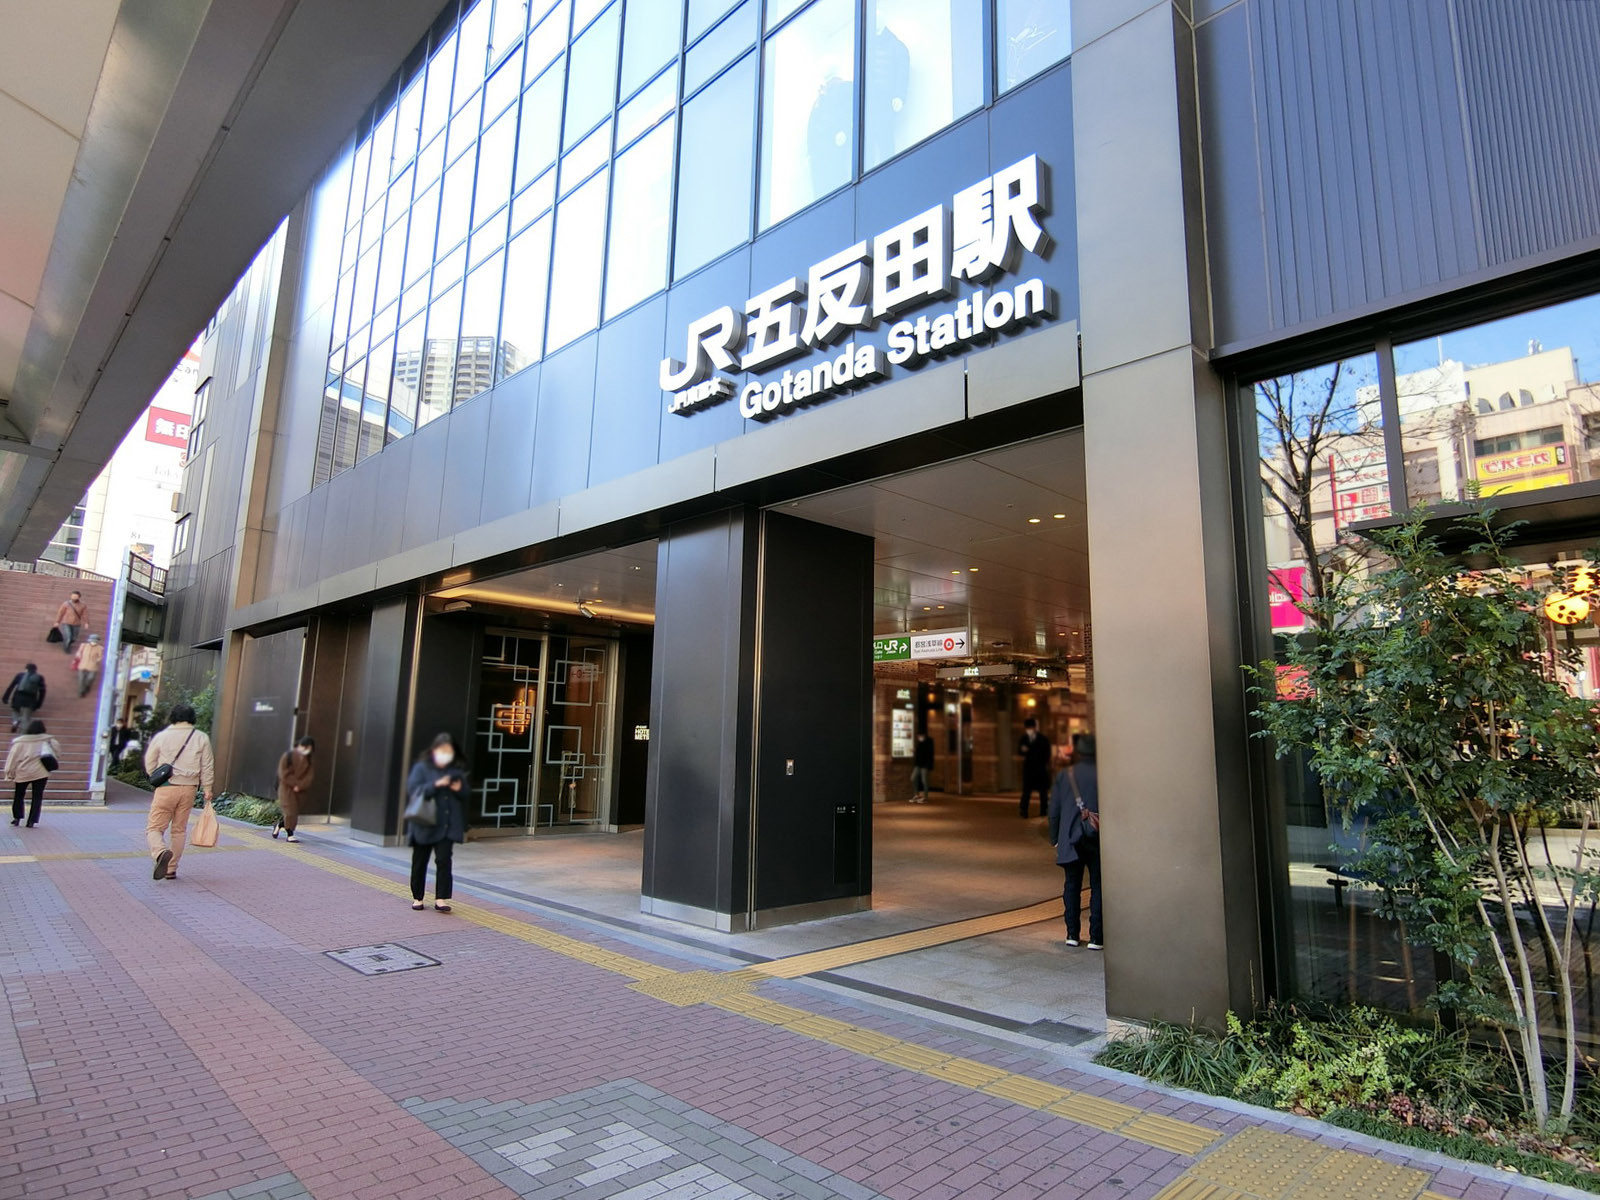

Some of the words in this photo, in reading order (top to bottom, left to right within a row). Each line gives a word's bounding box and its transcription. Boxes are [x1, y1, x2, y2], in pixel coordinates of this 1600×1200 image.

[739, 343, 877, 420] Gotanda
[886, 278, 1046, 364] Station
[884, 640, 899, 651] JR
